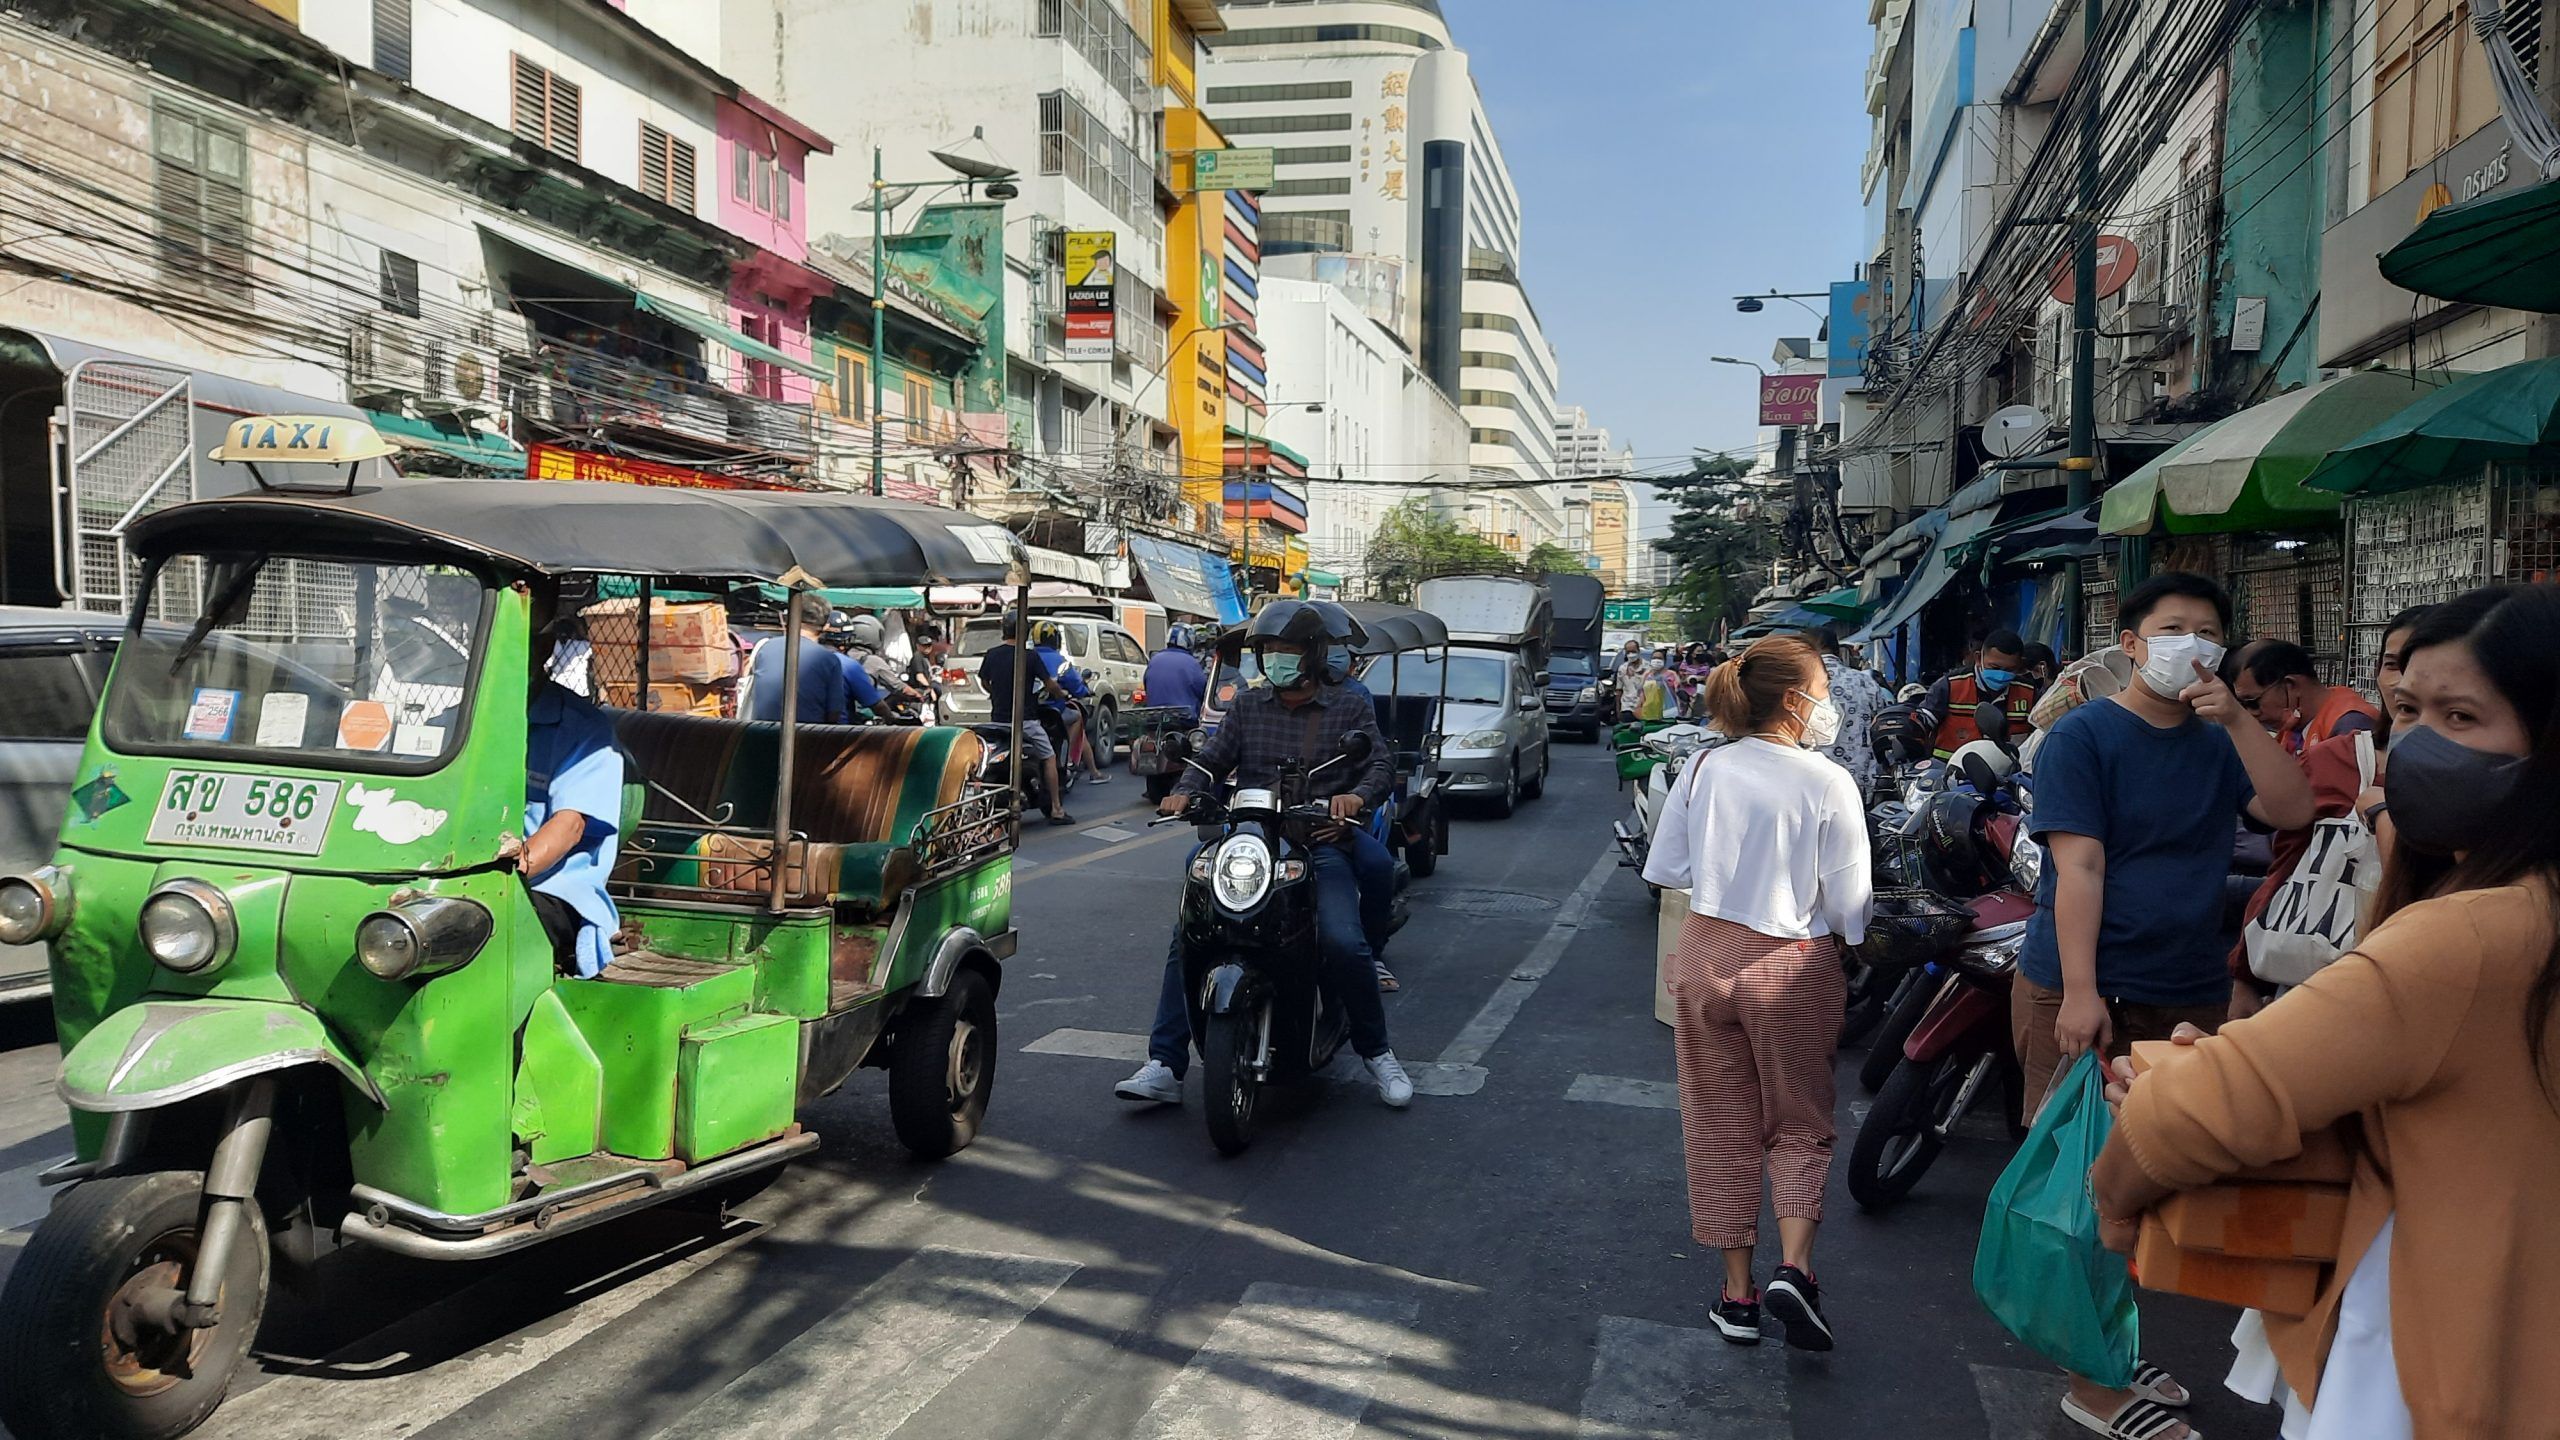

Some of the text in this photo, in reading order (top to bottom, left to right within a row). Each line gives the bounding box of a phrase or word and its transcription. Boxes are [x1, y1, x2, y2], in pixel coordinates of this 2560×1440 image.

[1202, 261, 1218, 322] CP
[239, 423, 333, 449] TAXI
[2014, 699, 2027, 712] 10
[167, 774, 320, 820] สข 586
[174, 823, 296, 845] กรุงเทพมหานคร
